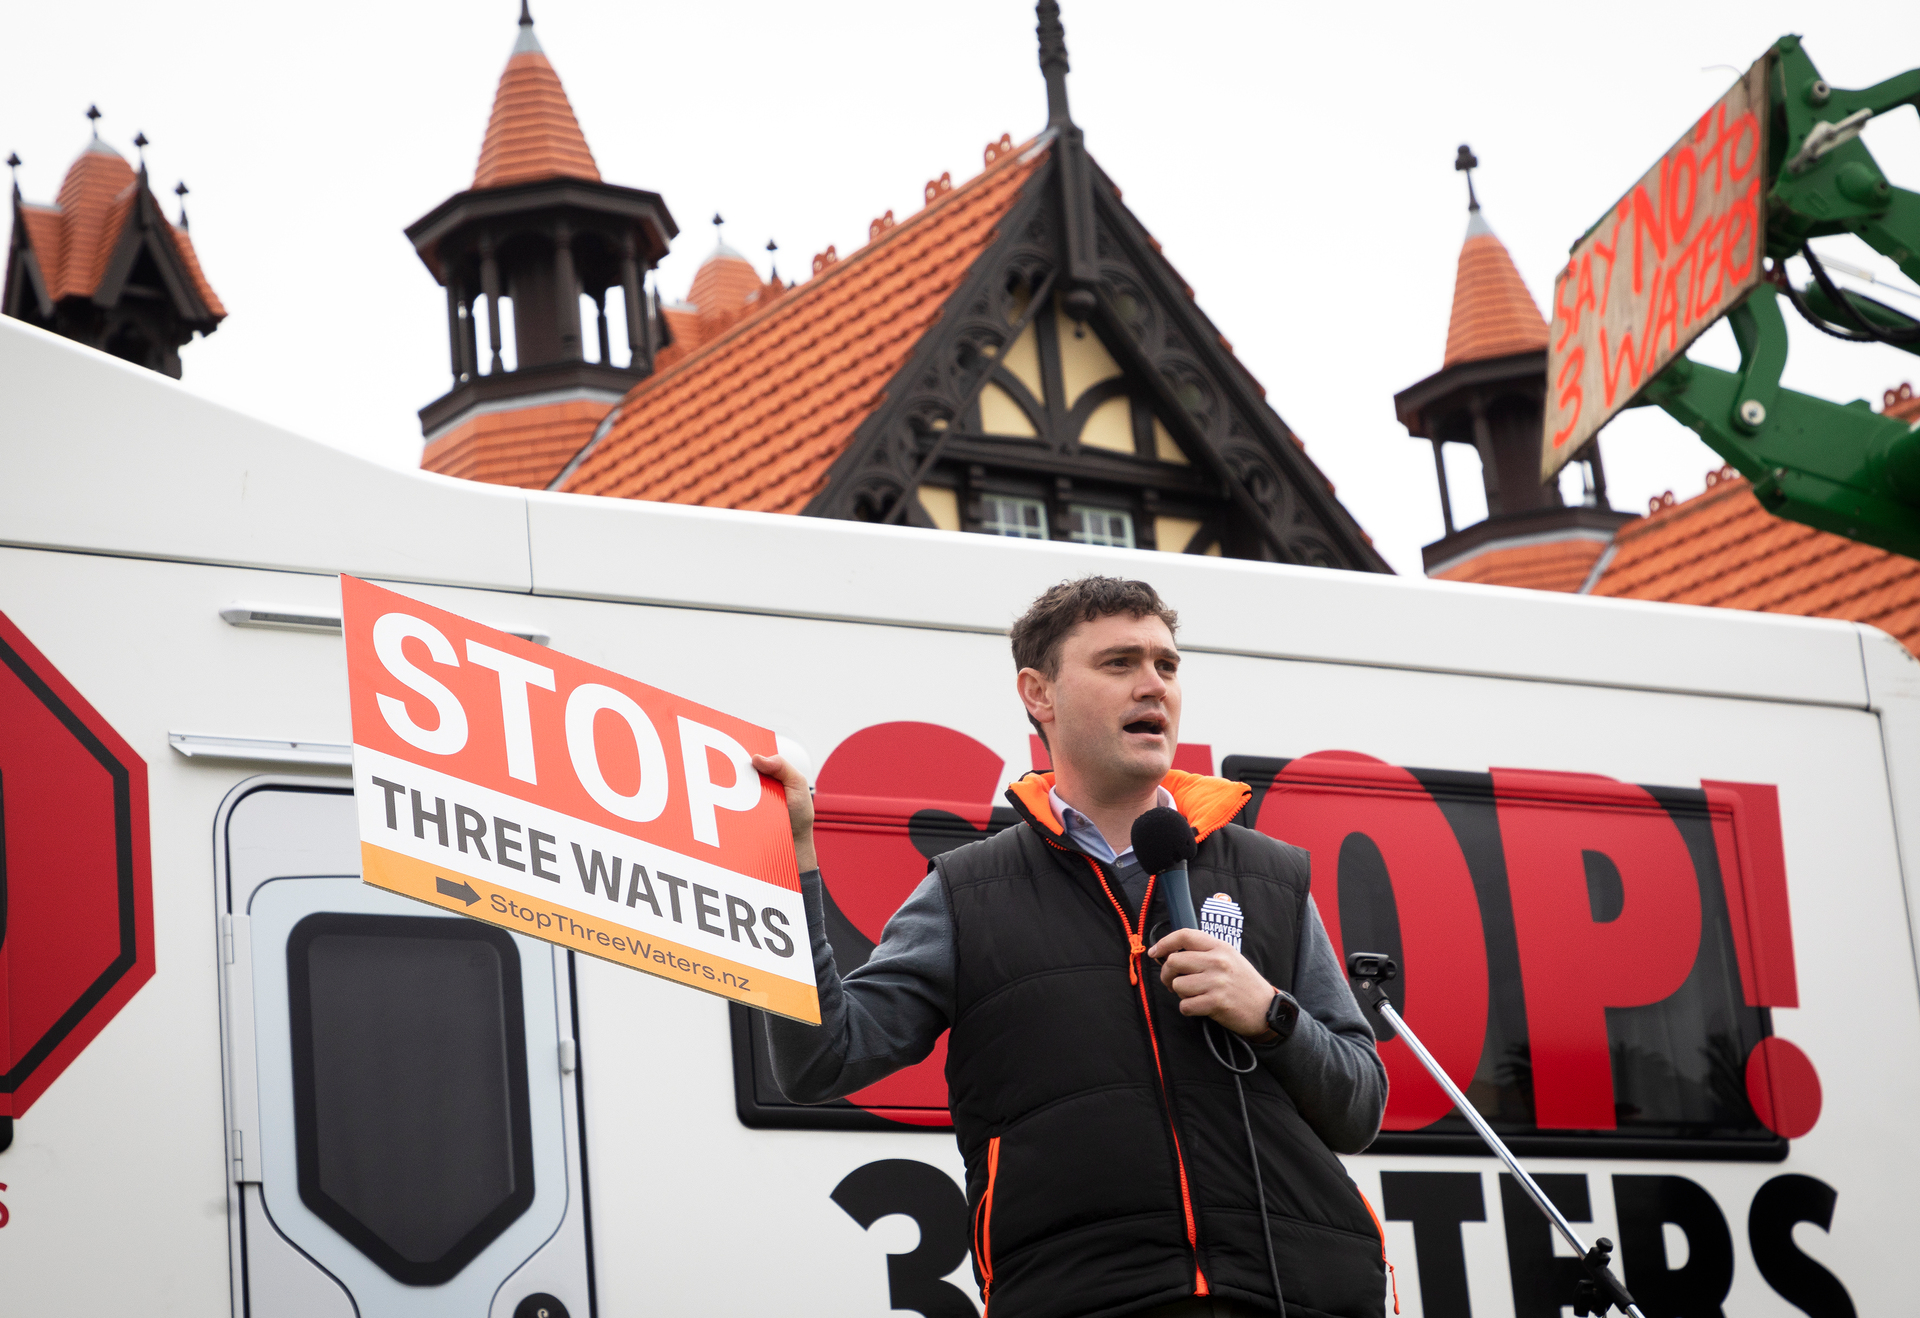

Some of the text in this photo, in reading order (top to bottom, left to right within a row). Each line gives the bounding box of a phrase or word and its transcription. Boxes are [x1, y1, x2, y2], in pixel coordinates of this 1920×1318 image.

[1553, 177, 1761, 449] 3 WATERS
[1555, 222, 1620, 353] SAY
[372, 612, 762, 849] STOP
[371, 775, 795, 958] THREE WATERS
[490, 893, 751, 992] StopThreeWaters.nz
[813, 720, 1823, 1140] SOP!
[829, 1158, 983, 1318] 3
